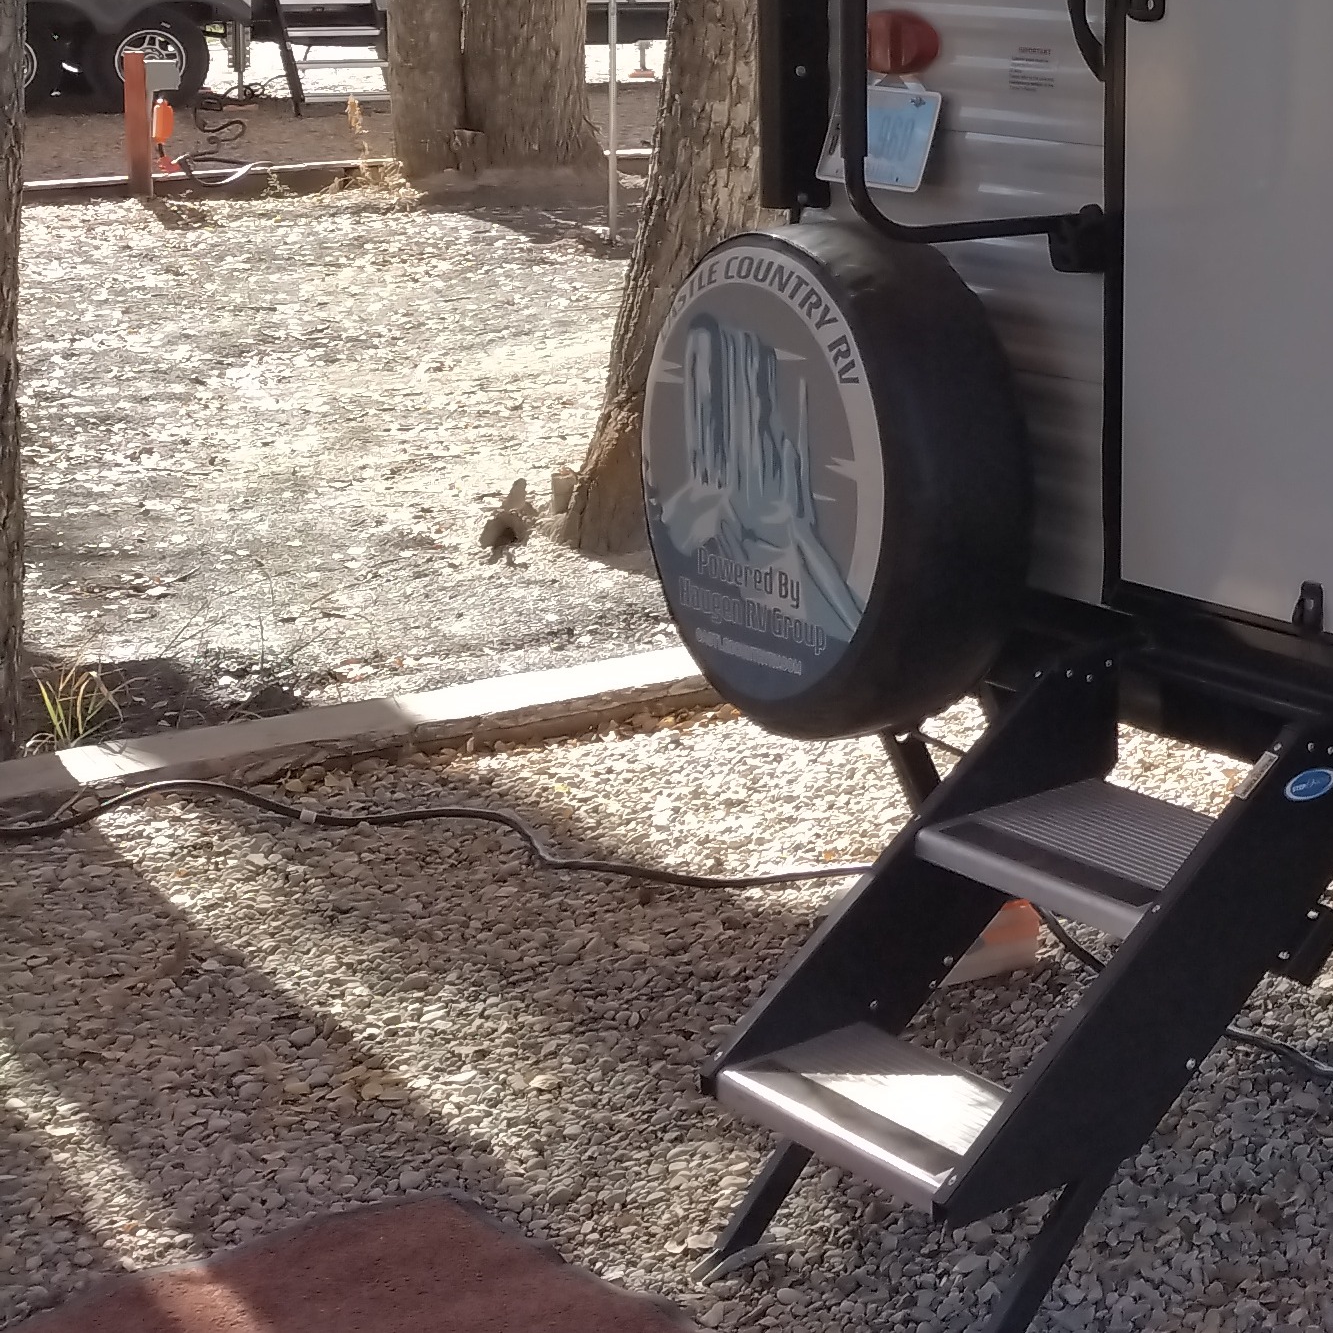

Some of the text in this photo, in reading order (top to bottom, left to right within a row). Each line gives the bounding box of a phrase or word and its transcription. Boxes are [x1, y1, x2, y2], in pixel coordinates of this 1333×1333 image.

[724, 255, 839, 331] COUNTRY
[827, 334, 860, 385] RV
[679, 576, 744, 625] Haugen
[745, 597, 768, 633] RV
[772, 607, 827, 656] Group
[697, 546, 801, 610] Powered By
